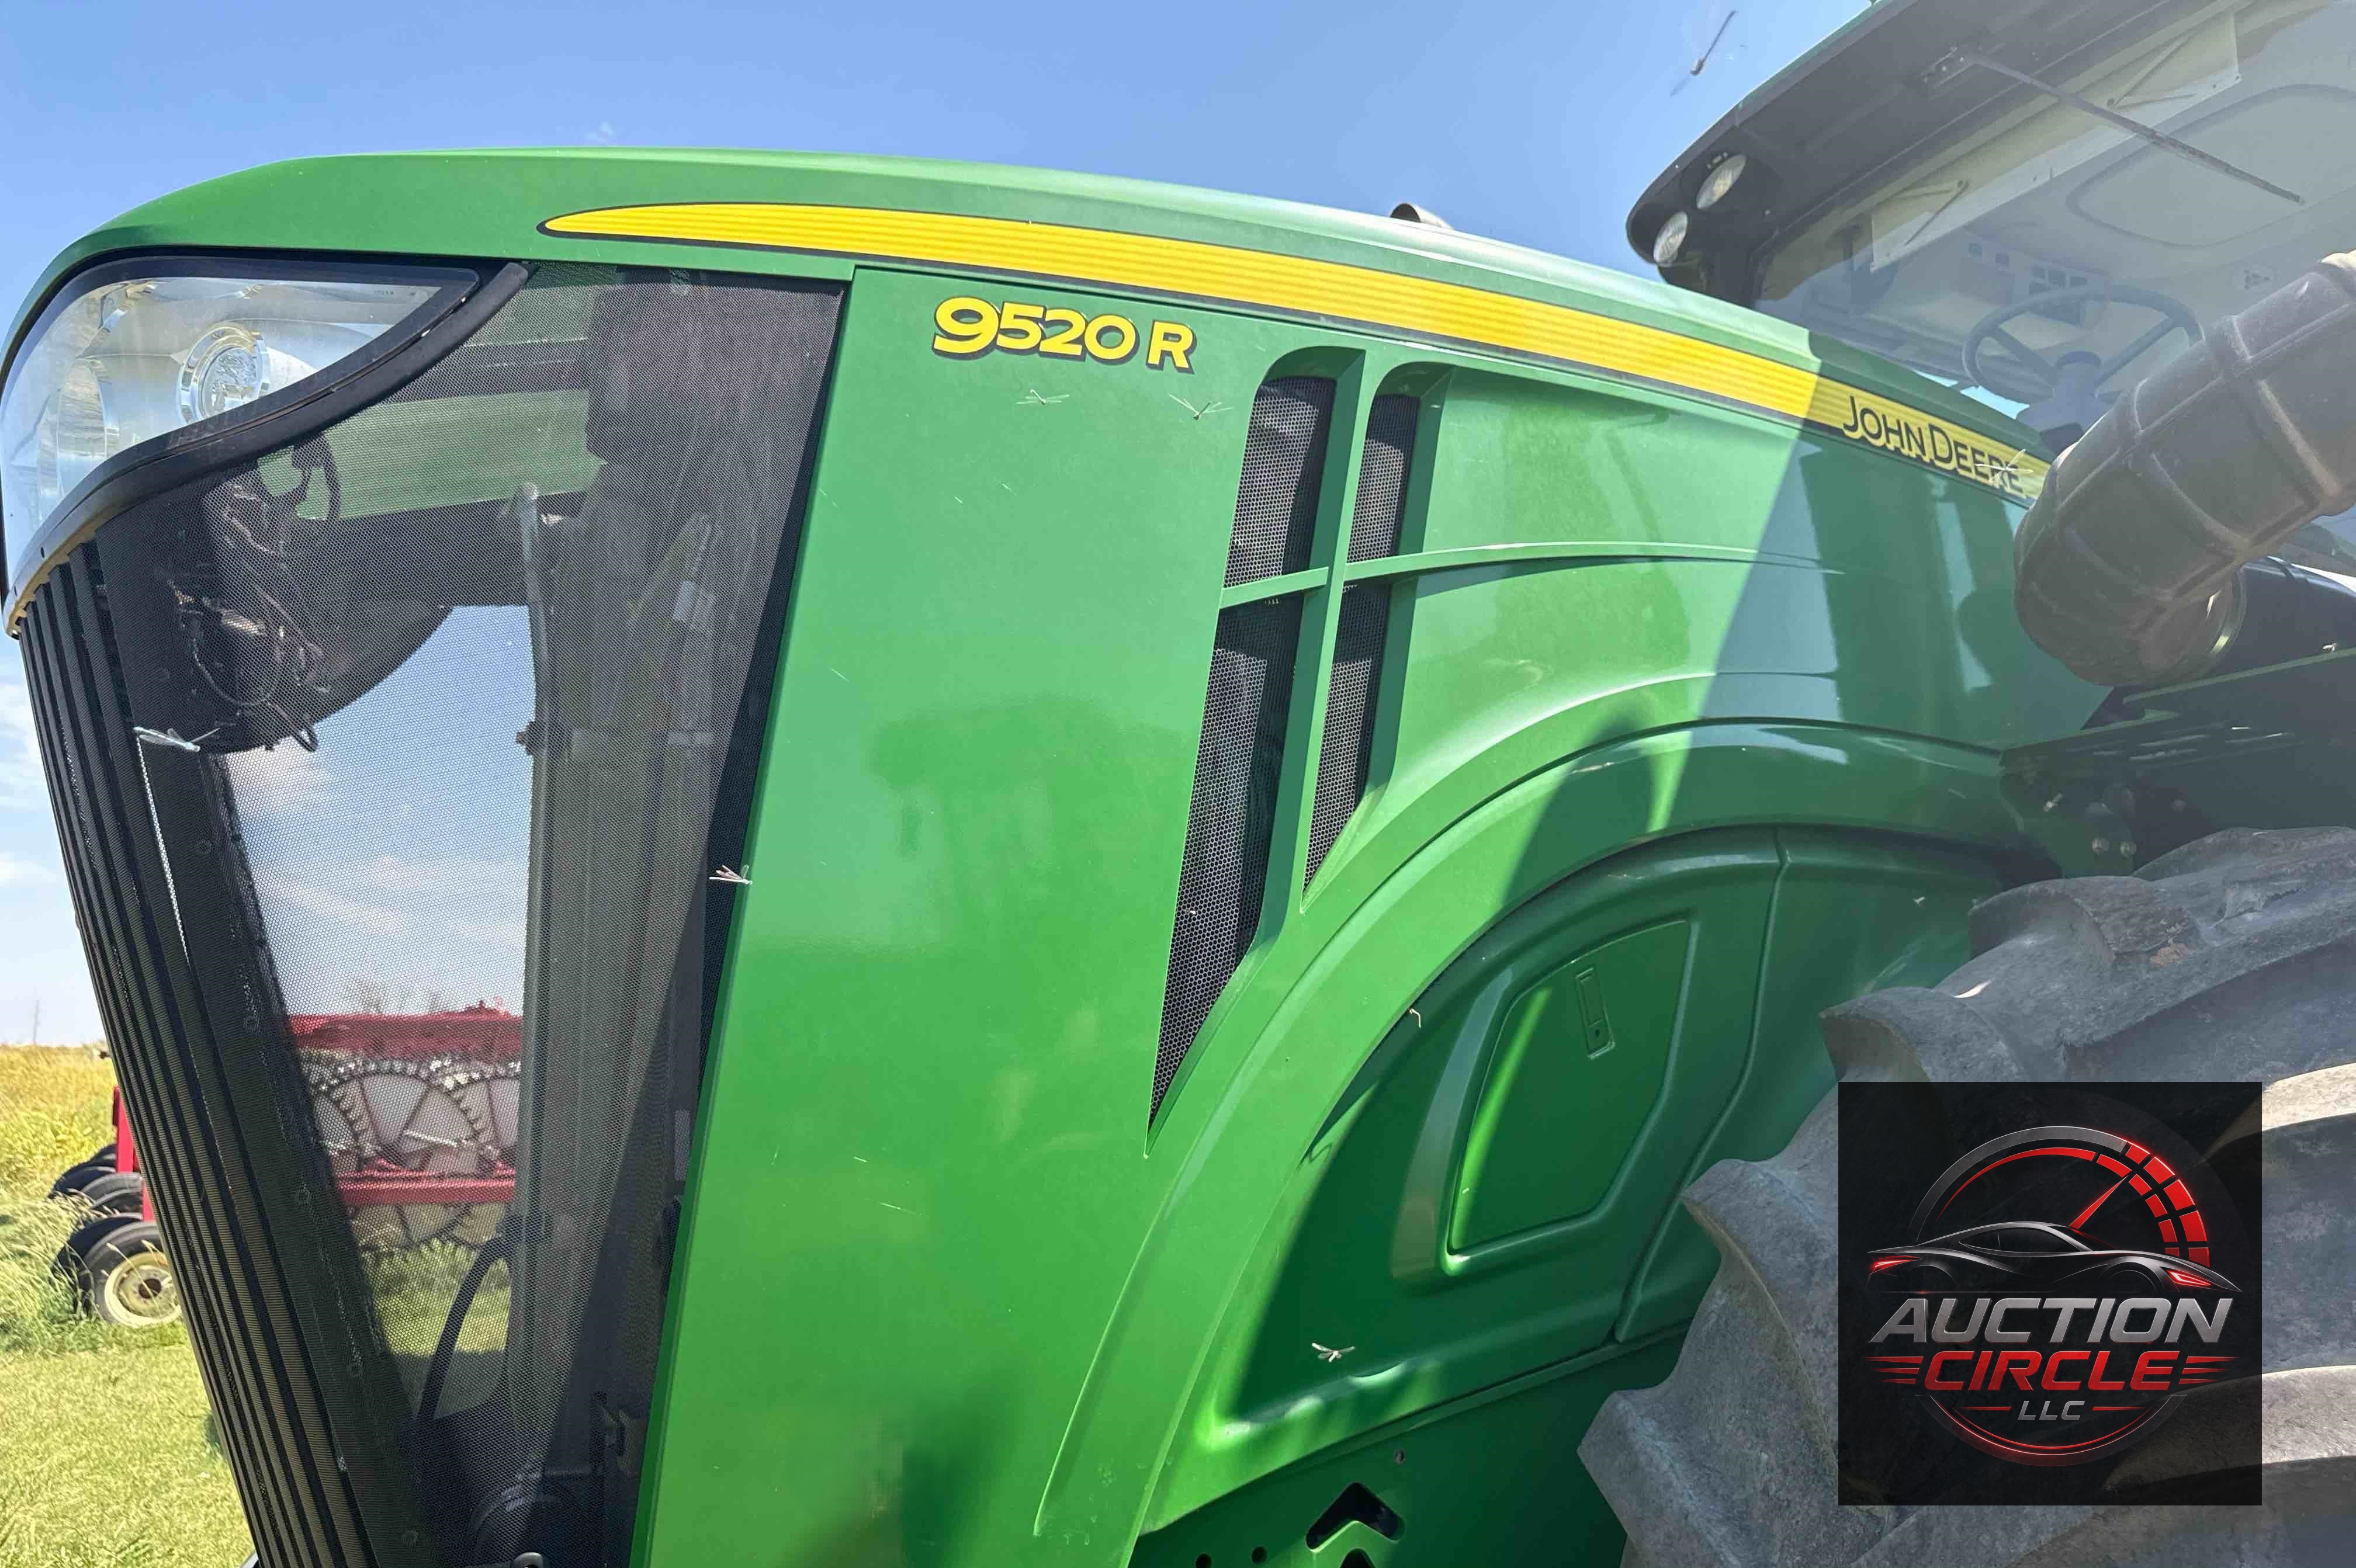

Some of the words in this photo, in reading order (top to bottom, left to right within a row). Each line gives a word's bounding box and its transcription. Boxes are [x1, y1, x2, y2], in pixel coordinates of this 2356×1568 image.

[933, 296, 1140, 366] 9520
[1146, 321, 1195, 374] R
[1842, 395, 1928, 459] JOHN
[1929, 423, 2025, 494] DEERE
